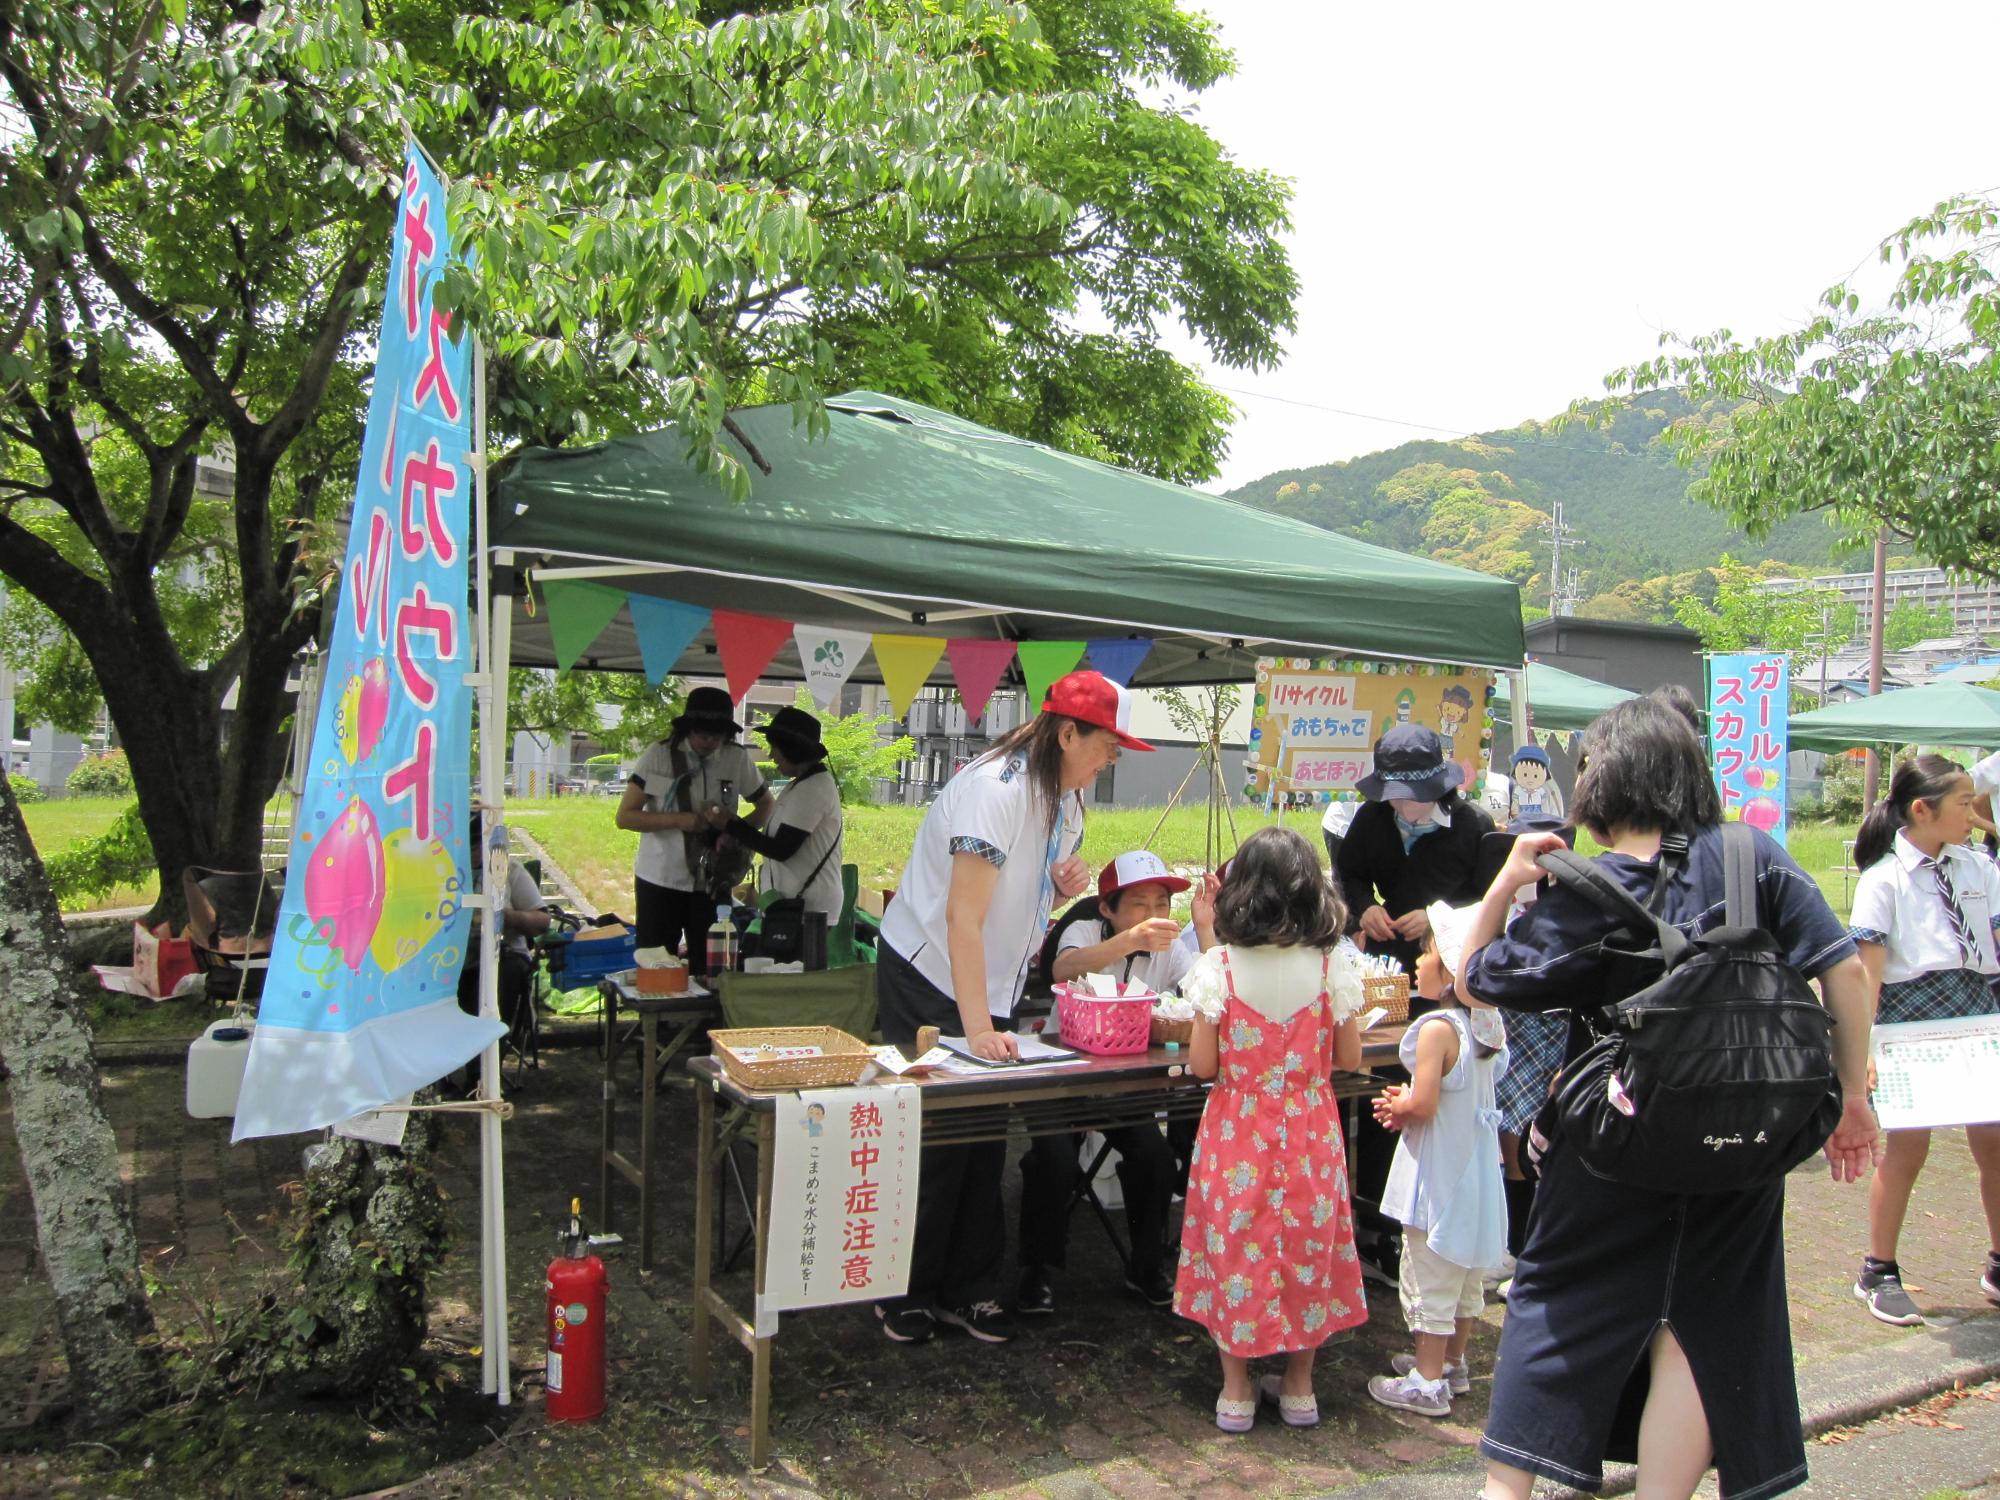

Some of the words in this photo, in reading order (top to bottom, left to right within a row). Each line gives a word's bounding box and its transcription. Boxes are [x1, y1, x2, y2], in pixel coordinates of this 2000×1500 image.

[1273, 685, 1348, 706] リサイクル
[1291, 716, 1367, 737] おもちゃで
[1715, 678, 1744, 808] スカウト
[1749, 658, 1783, 762] ガール
[840, 1101, 883, 1291] 熱中症注意
